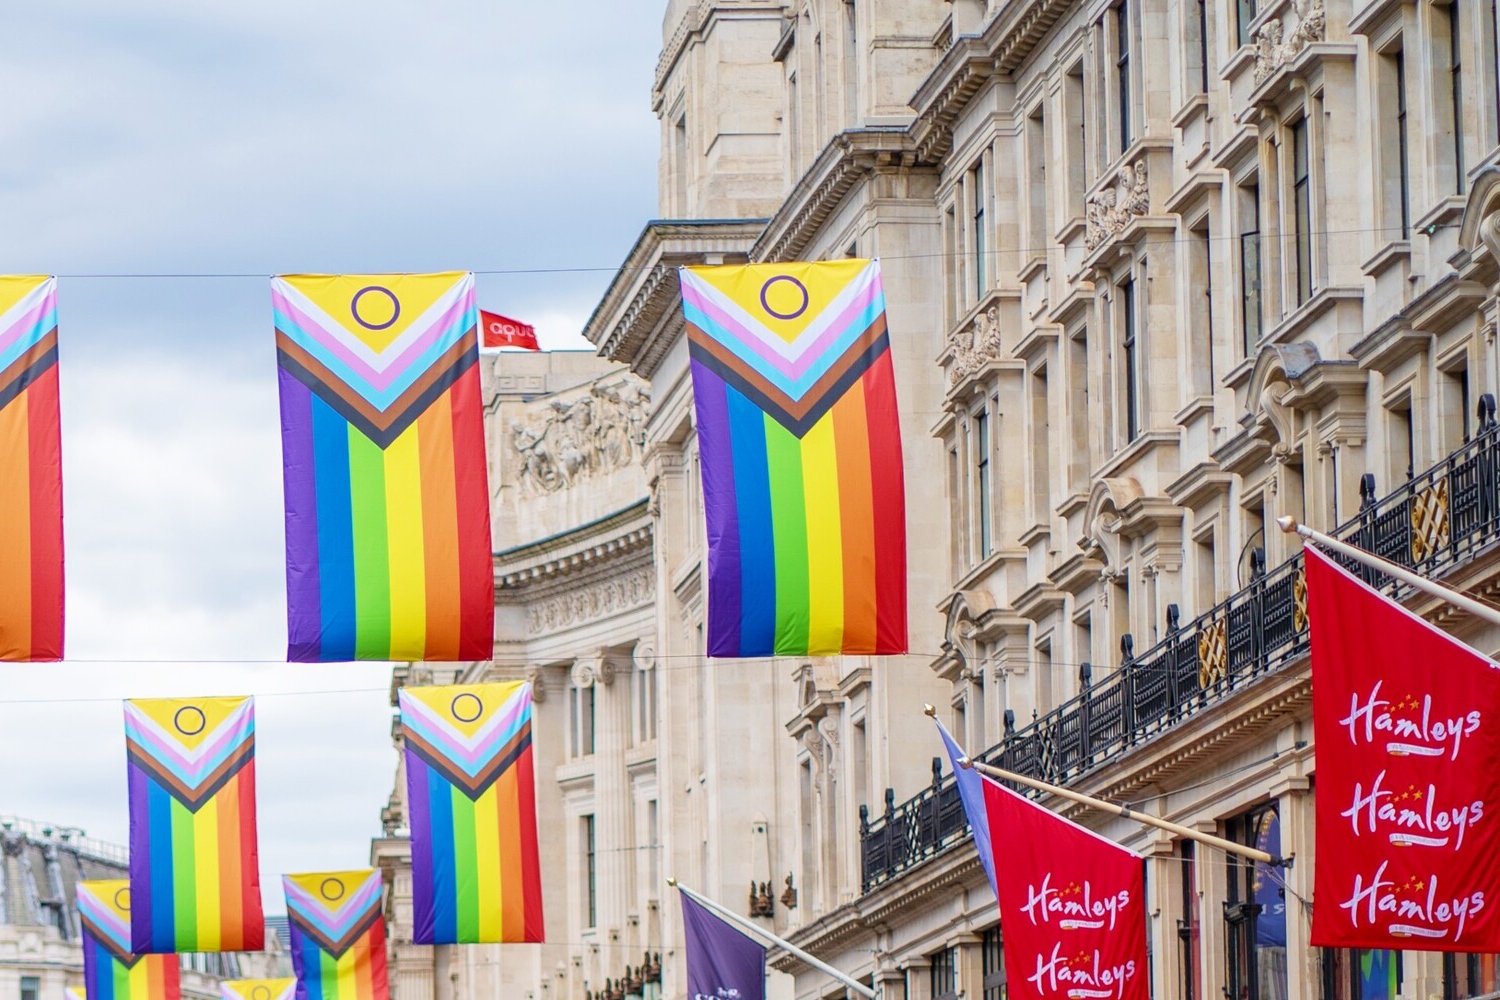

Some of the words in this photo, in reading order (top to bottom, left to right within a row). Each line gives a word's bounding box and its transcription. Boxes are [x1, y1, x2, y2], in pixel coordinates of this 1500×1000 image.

[1338, 679, 1481, 762] Hamleys
[1340, 769, 1484, 851] Hamleys
[1019, 872, 1130, 931] Hamleys
[1339, 859, 1484, 943] Hamleys
[1027, 940, 1135, 1000] Hamleys
